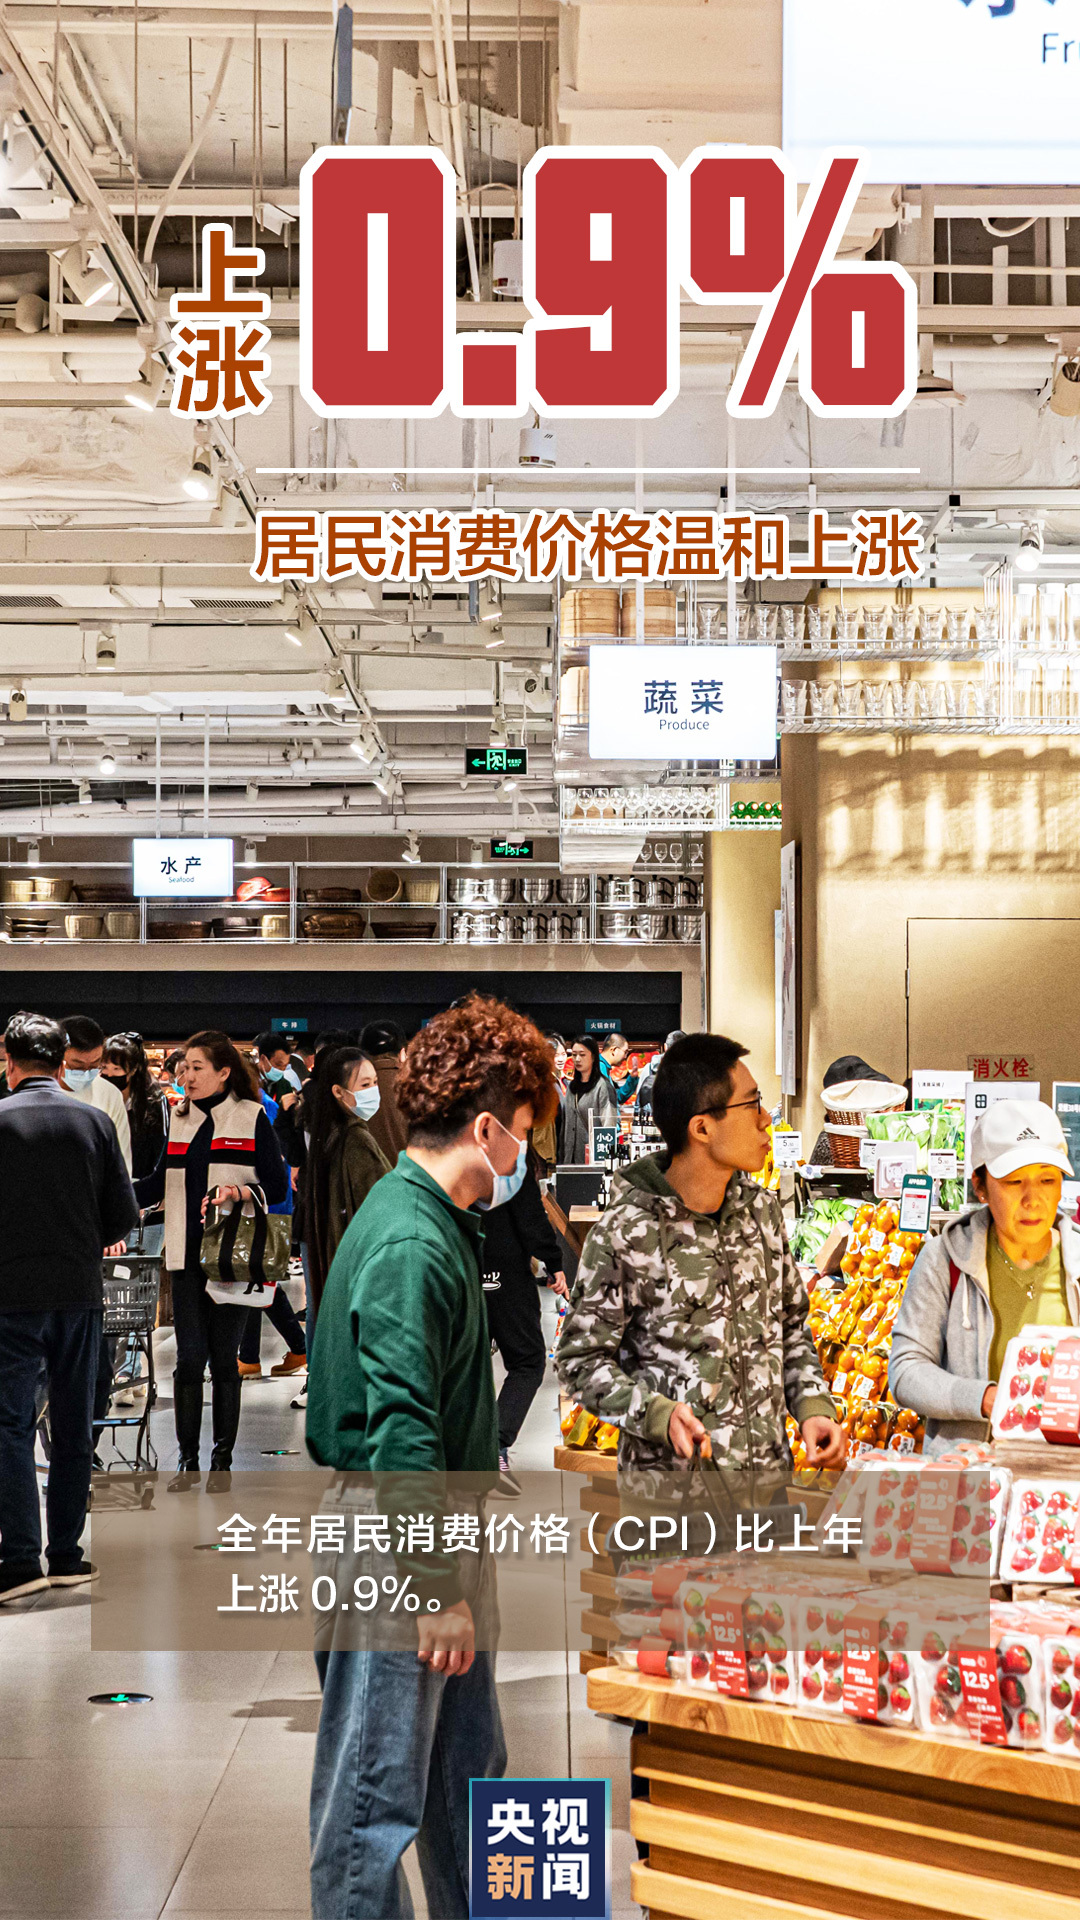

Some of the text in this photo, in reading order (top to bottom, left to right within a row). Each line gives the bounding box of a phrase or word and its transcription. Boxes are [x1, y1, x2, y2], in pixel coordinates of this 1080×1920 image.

[1042, 33, 1080, 64] Fr
[644, 679, 724, 715] 蔬菜
[659, 719, 710, 730] Produce
[160, 856, 202, 875] 水产
[168, 876, 195, 884] Seafood
[973, 1057, 1030, 1079] 消火栓
[596, 1132, 614, 1143] 小心
